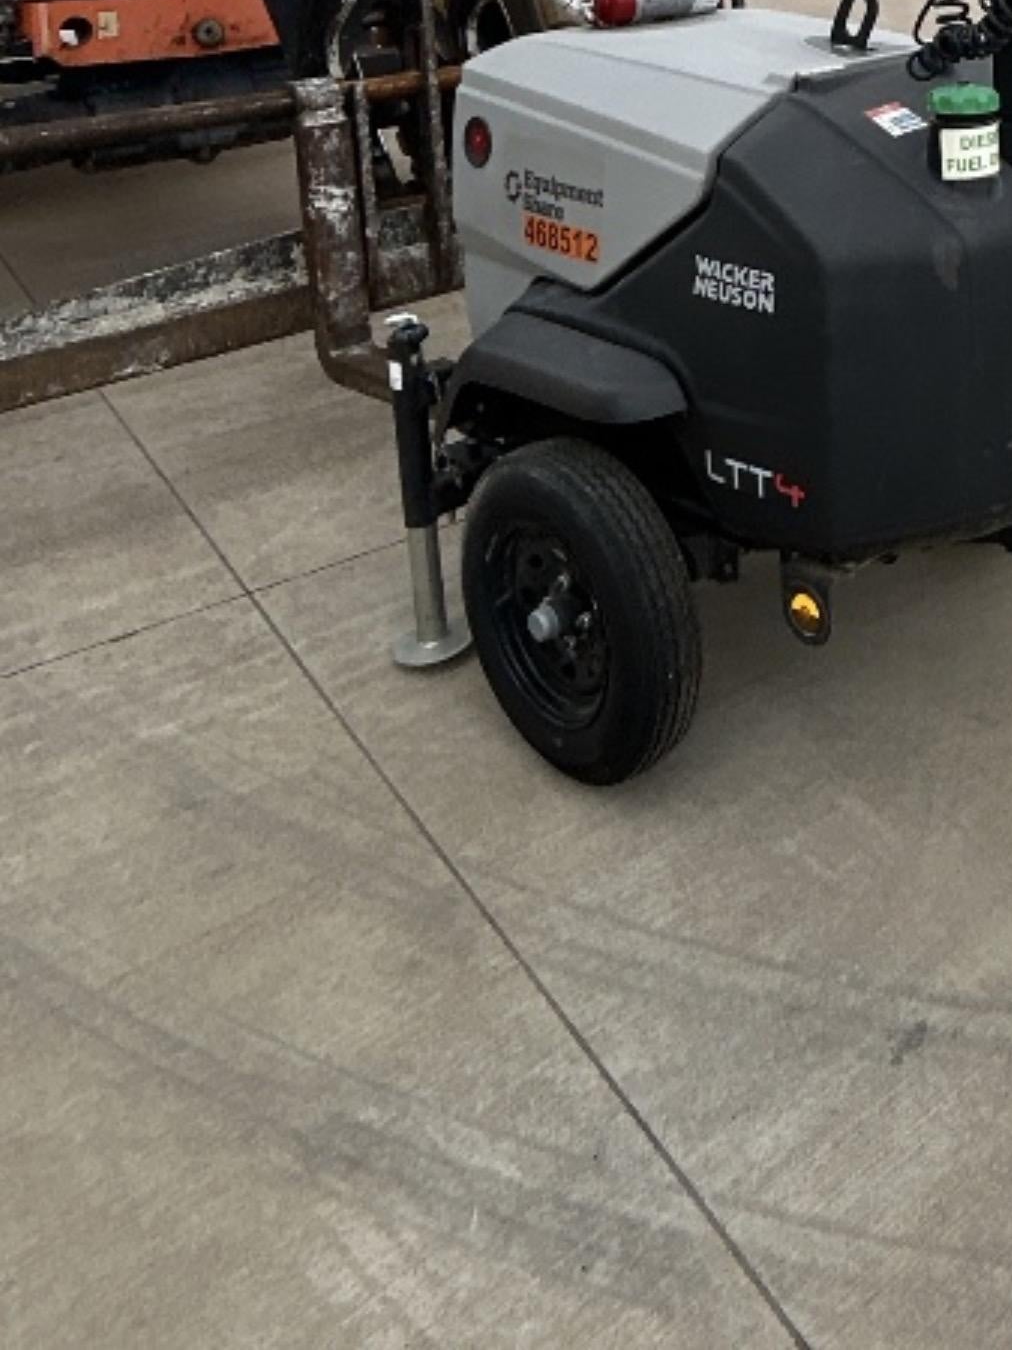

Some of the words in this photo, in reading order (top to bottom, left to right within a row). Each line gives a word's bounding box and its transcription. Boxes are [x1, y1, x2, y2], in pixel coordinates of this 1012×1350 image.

[946, 155, 988, 172] FUEL
[524, 215, 598, 263] 468512
[692, 275, 775, 313] NEUSON
[704, 449, 806, 508] LTT4
